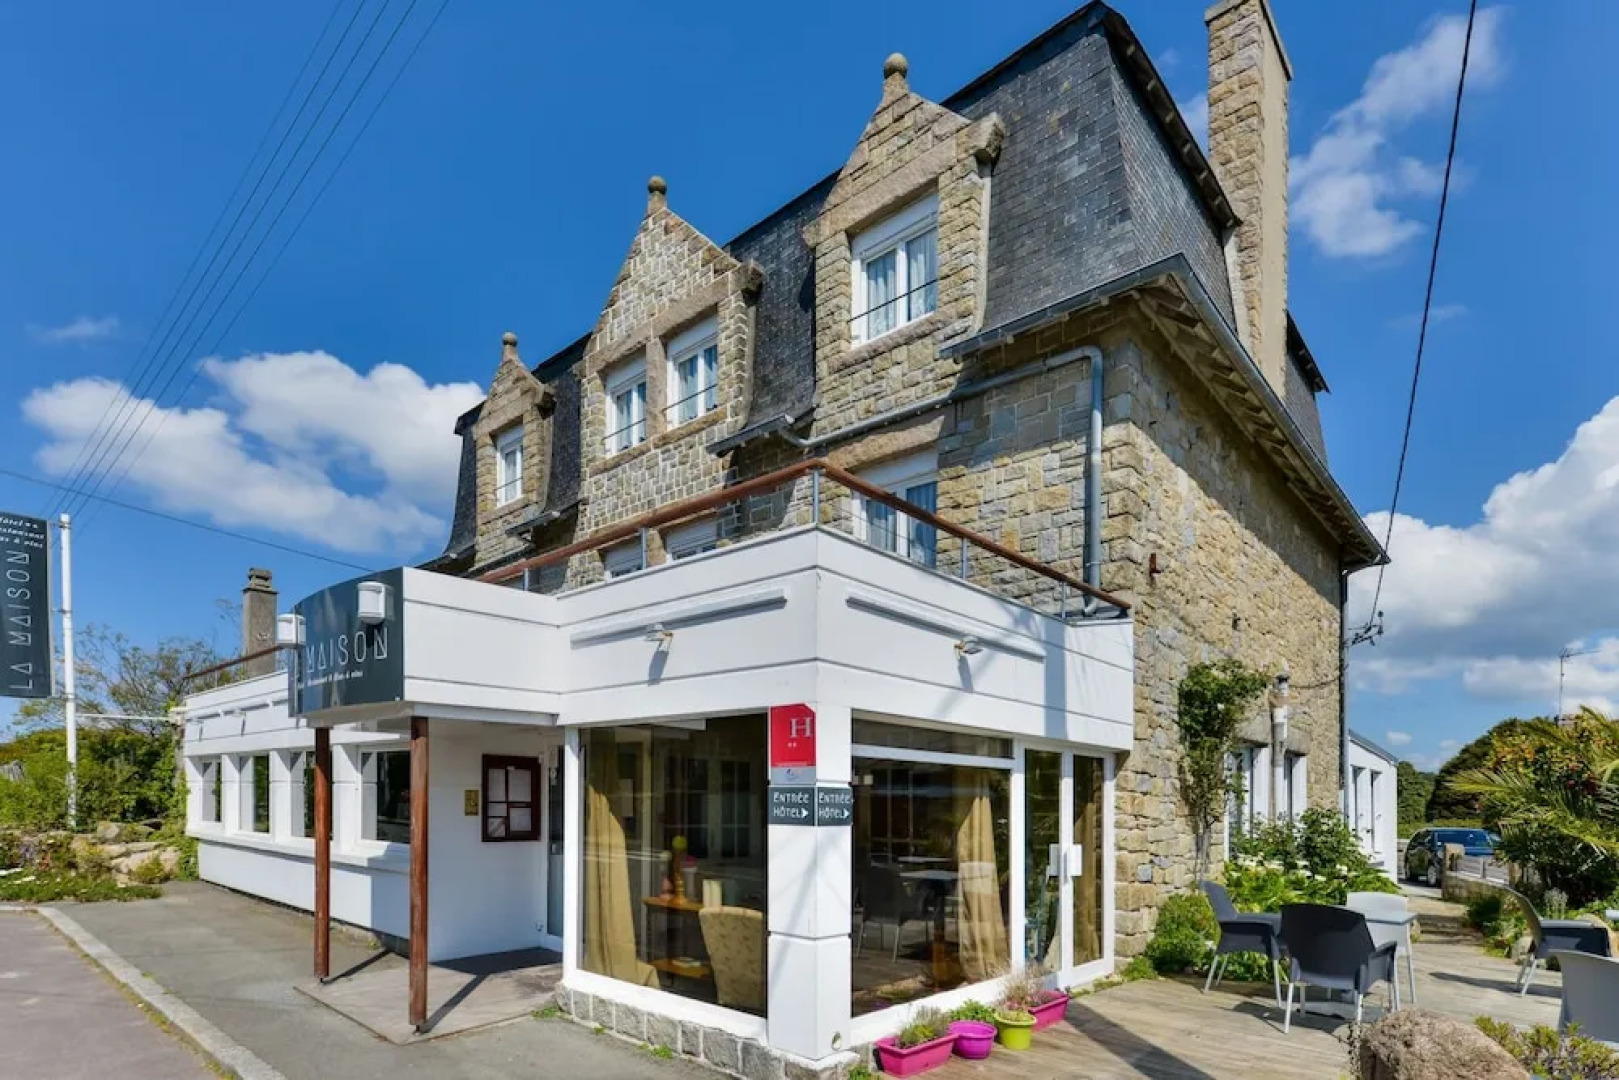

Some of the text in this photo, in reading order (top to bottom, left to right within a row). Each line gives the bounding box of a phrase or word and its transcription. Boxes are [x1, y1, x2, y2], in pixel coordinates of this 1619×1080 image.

[6, 550, 33, 690] LA MAISON
[306, 626, 388, 673] MAISON
[790, 717, 813, 738] H
